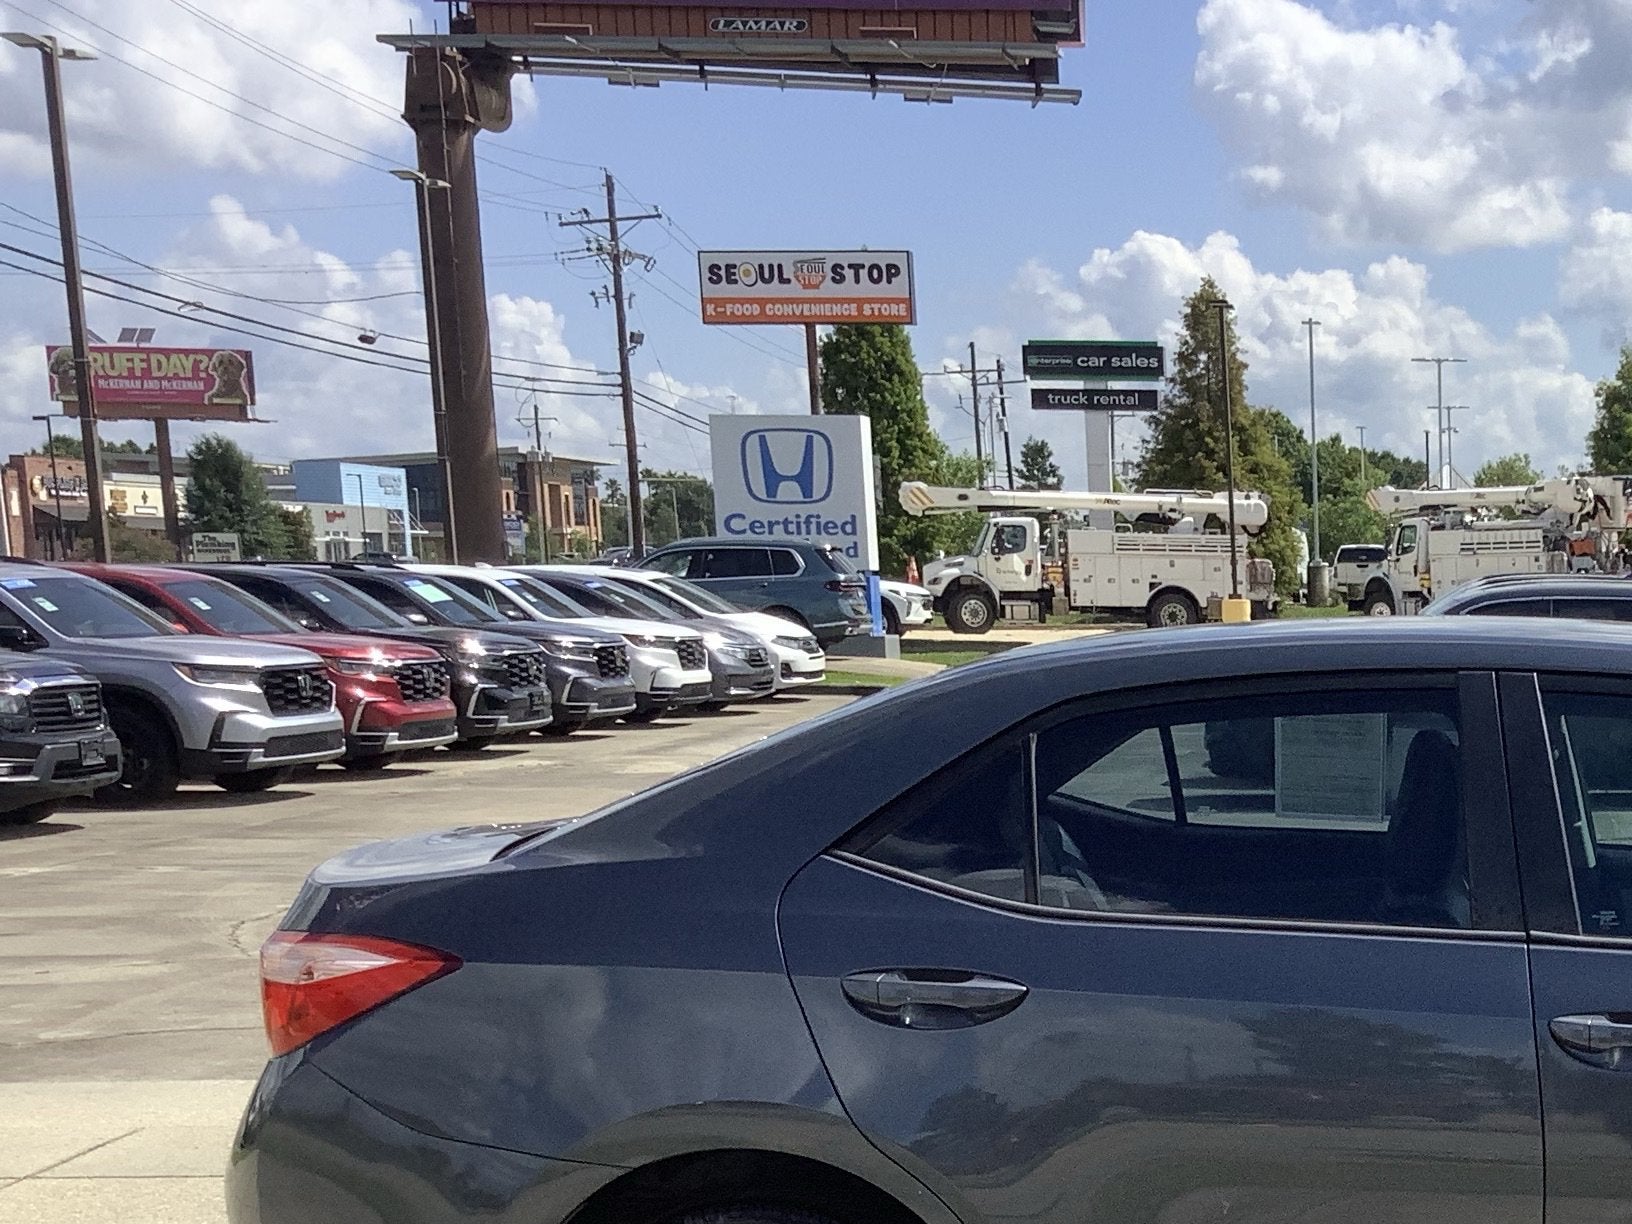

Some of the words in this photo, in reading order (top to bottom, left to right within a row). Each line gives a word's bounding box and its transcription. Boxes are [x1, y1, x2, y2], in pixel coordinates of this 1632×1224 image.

[718, 19, 798, 31] LAMAR
[708, 262, 792, 287] SEOUL
[830, 263, 901, 284] STOP
[706, 303, 760, 316] K-FOOD
[765, 303, 858, 316] CONVENIENCE
[863, 304, 907, 316] STORE
[89, 352, 147, 376] RUFF
[150, 353, 209, 377] DAY?
[1077, 356, 1107, 367] car
[1111, 353, 1159, 368] sales
[143, 380, 160, 390] AND
[1048, 392, 1088, 405] truck
[1094, 393, 1139, 405] rental
[724, 513, 858, 536] Certified
